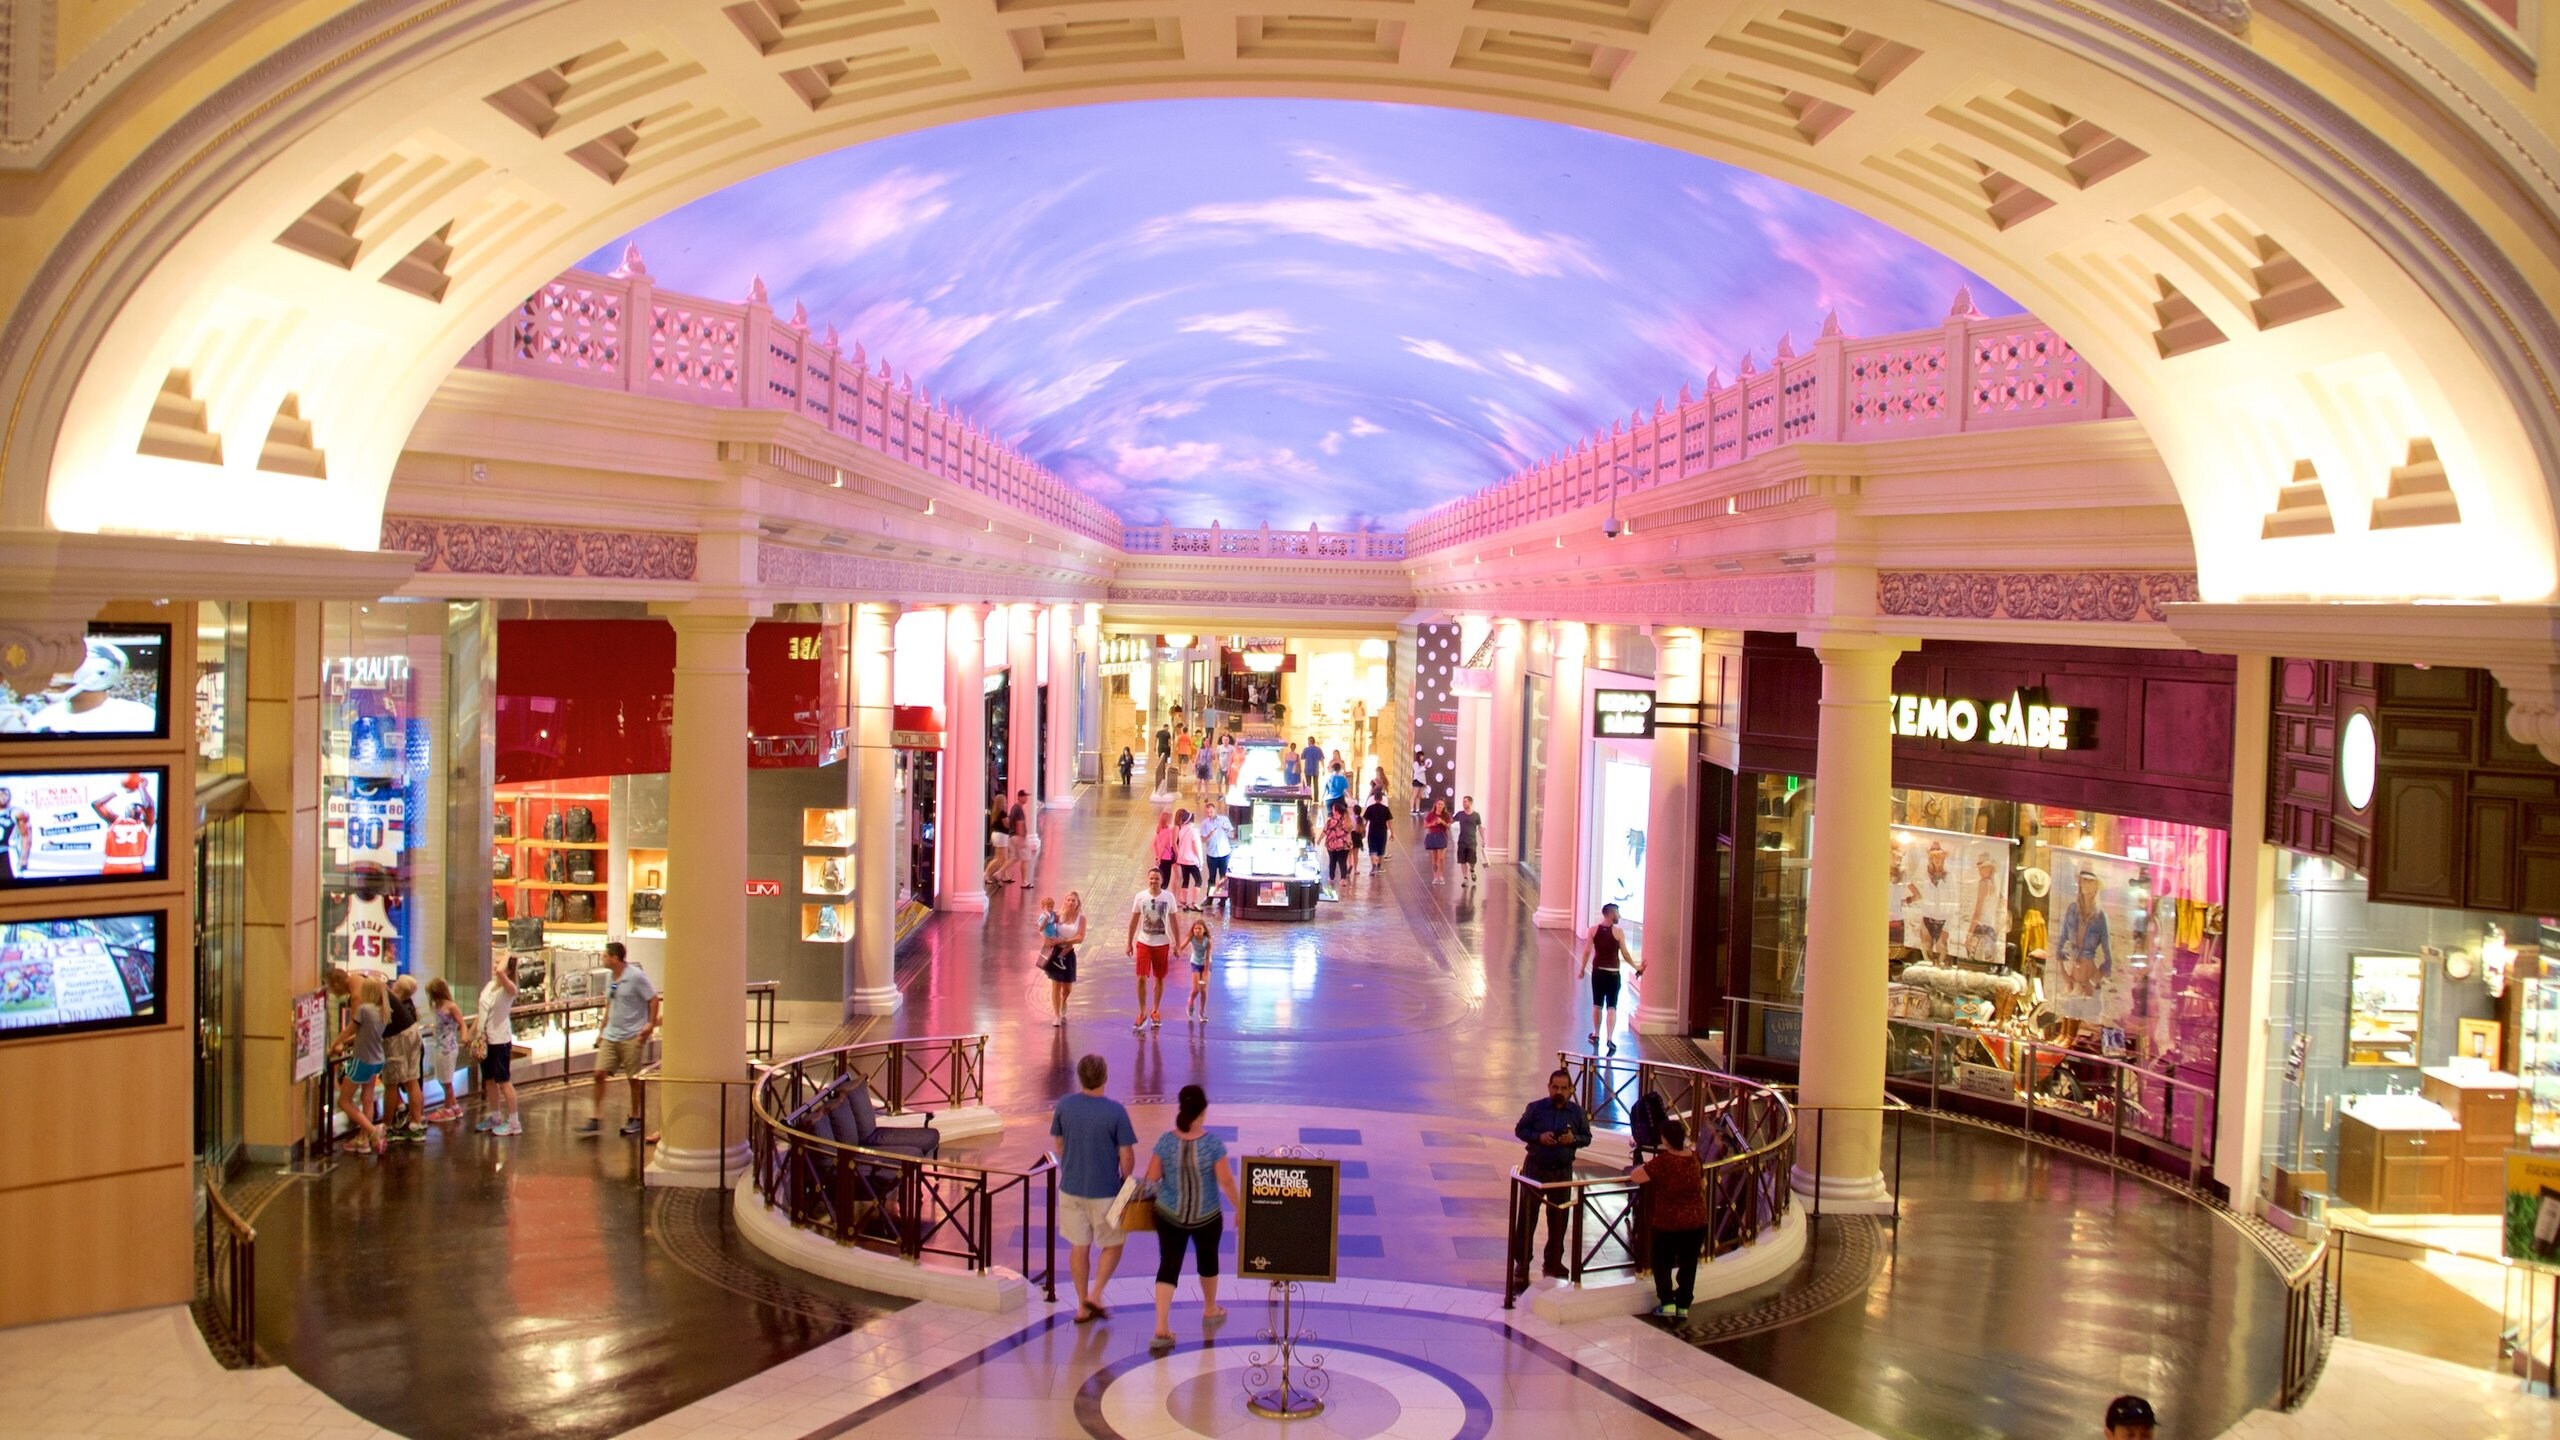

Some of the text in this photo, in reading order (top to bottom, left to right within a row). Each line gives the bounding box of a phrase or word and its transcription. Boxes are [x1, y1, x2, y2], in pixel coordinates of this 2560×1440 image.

[1988, 688, 2069, 750] SABE
[754, 738, 818, 757] TUMI
[330, 803, 345, 813] 80
[388, 804, 404, 815] 80
[348, 816, 384, 849] 80
[352, 920, 384, 933] JORDAN
[352, 935, 381, 957] 45
[1252, 1168, 1306, 1179] CAMELOT
[1252, 1177, 1308, 1188] GALLERIES
[1252, 1186, 1312, 1198] NOW OPEN
